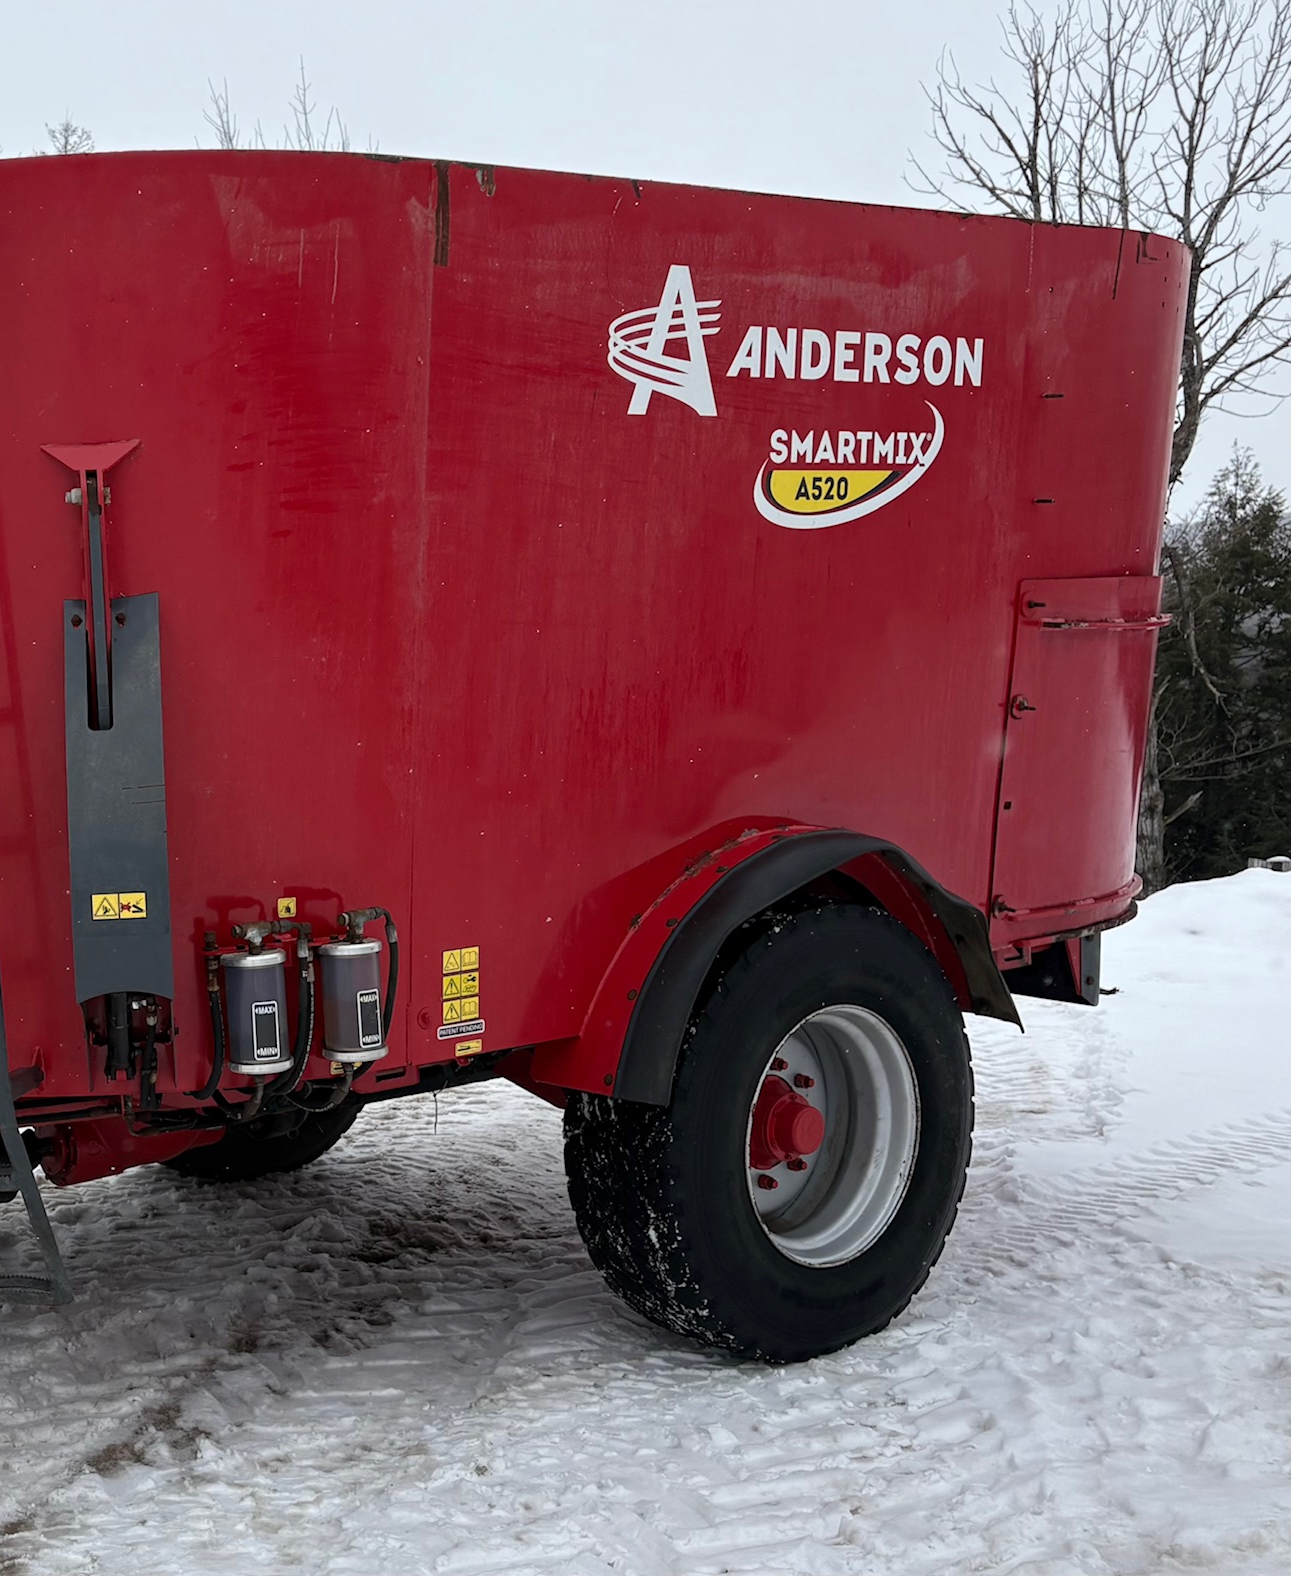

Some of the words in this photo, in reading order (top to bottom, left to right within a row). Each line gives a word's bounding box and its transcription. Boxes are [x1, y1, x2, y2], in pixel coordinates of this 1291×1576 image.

[726, 325, 984, 387] ANDERSON
[795, 477, 849, 501] A520
[361, 994, 376, 1003] MAX
[258, 1005, 274, 1015] MAX
[364, 1034, 378, 1043] MIN
[259, 1047, 276, 1056] MIN
